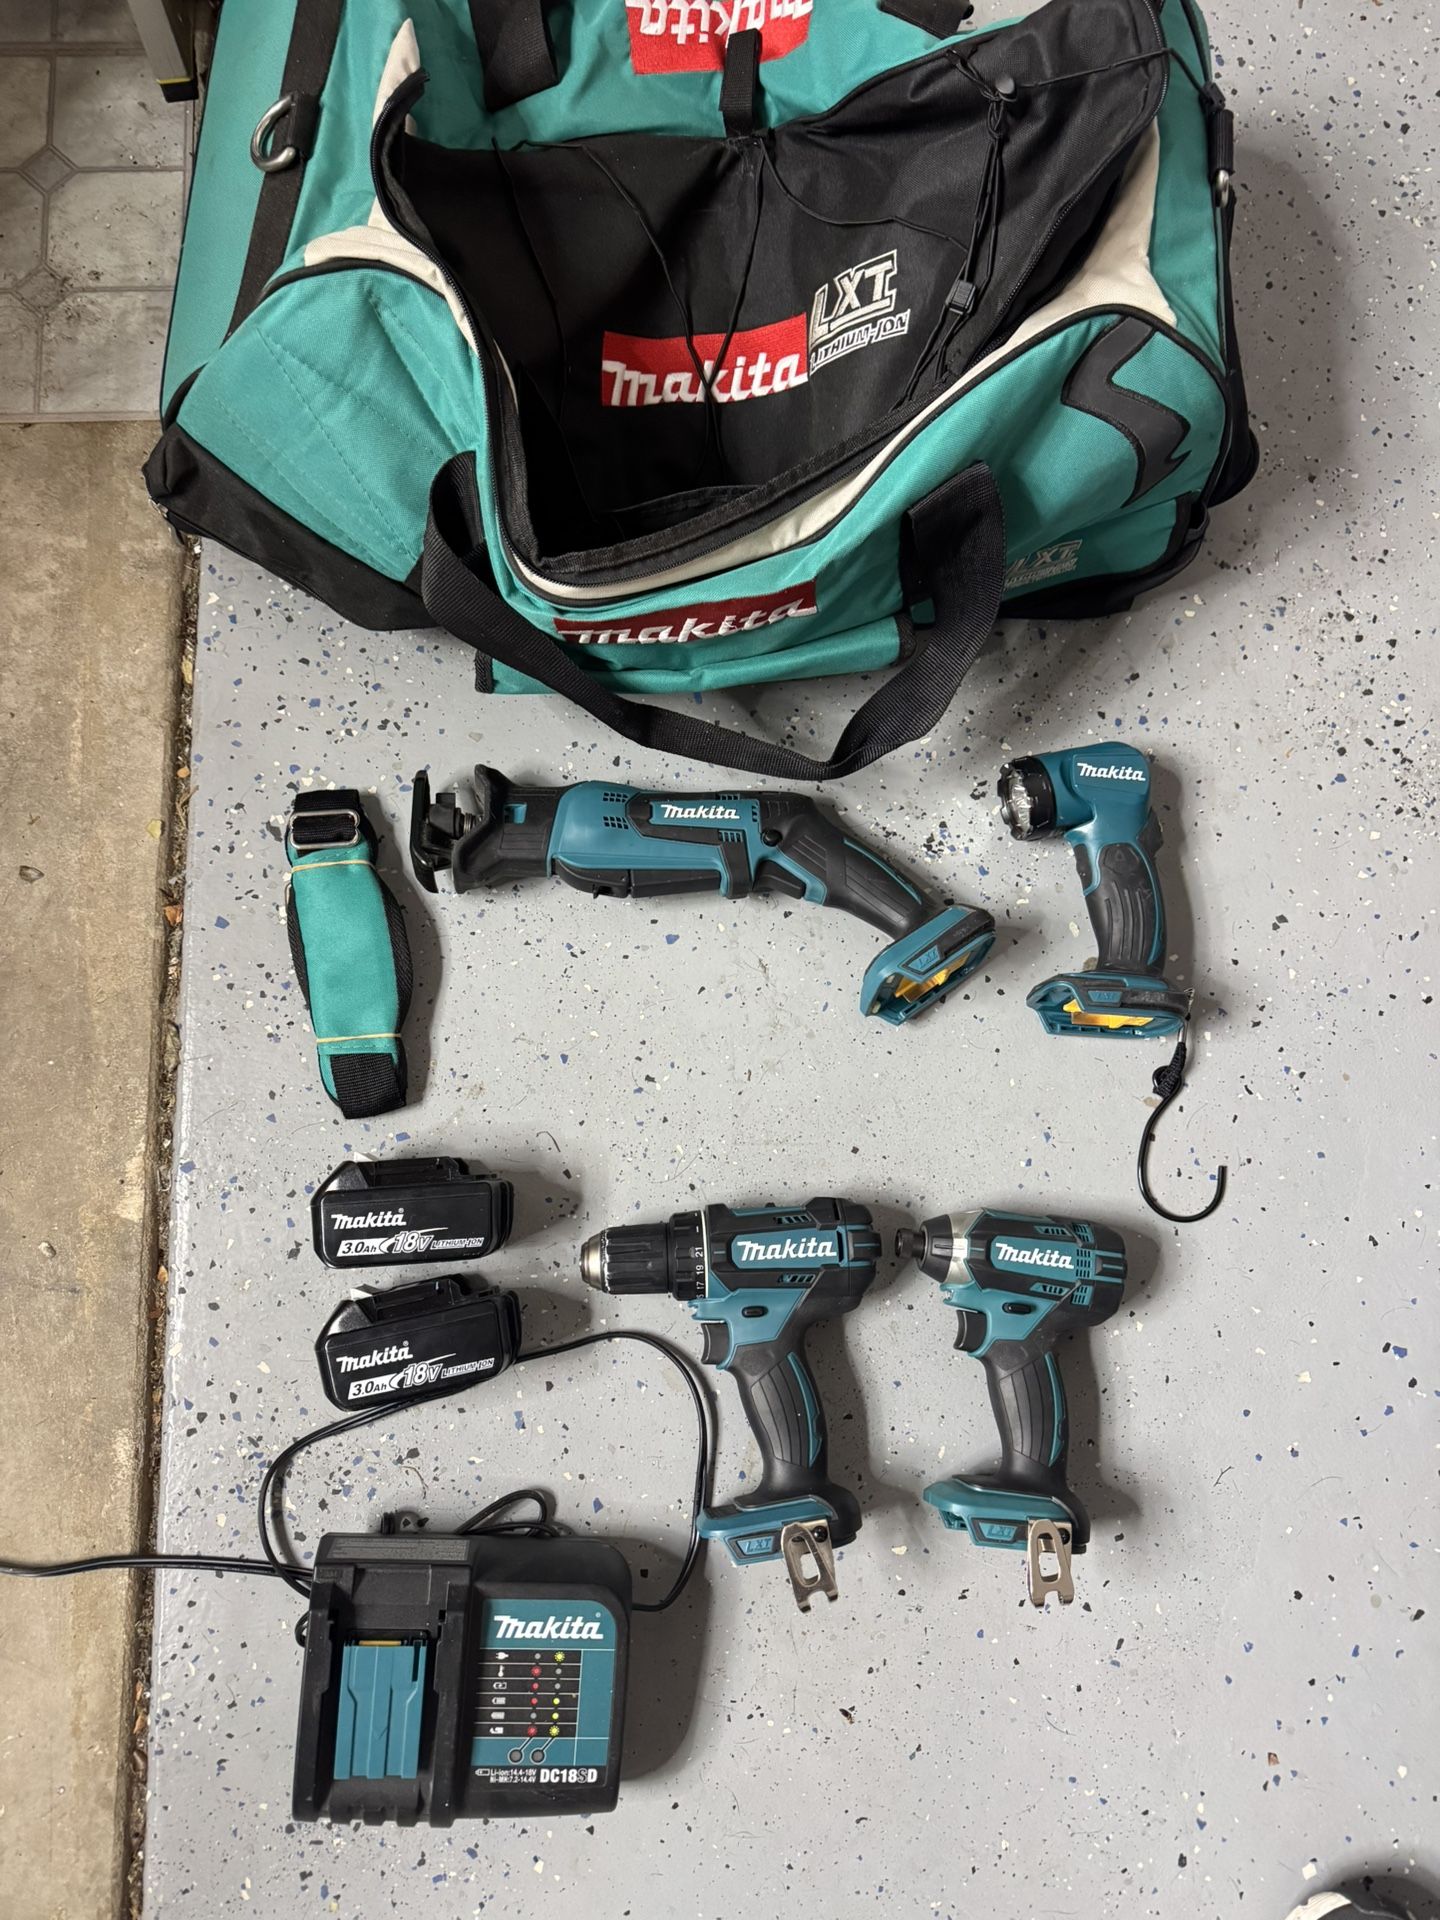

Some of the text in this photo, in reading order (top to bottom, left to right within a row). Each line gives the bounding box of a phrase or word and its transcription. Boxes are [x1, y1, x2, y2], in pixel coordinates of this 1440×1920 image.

[809, 249, 898, 350] LXT
[342, 1231, 485, 1255] 3.0Ah 18V LITHIUM-ION
[352, 1357, 495, 1397] 3.0Ah 18V LITHIUM-ION
[540, 1768, 598, 1783] DC18SD
